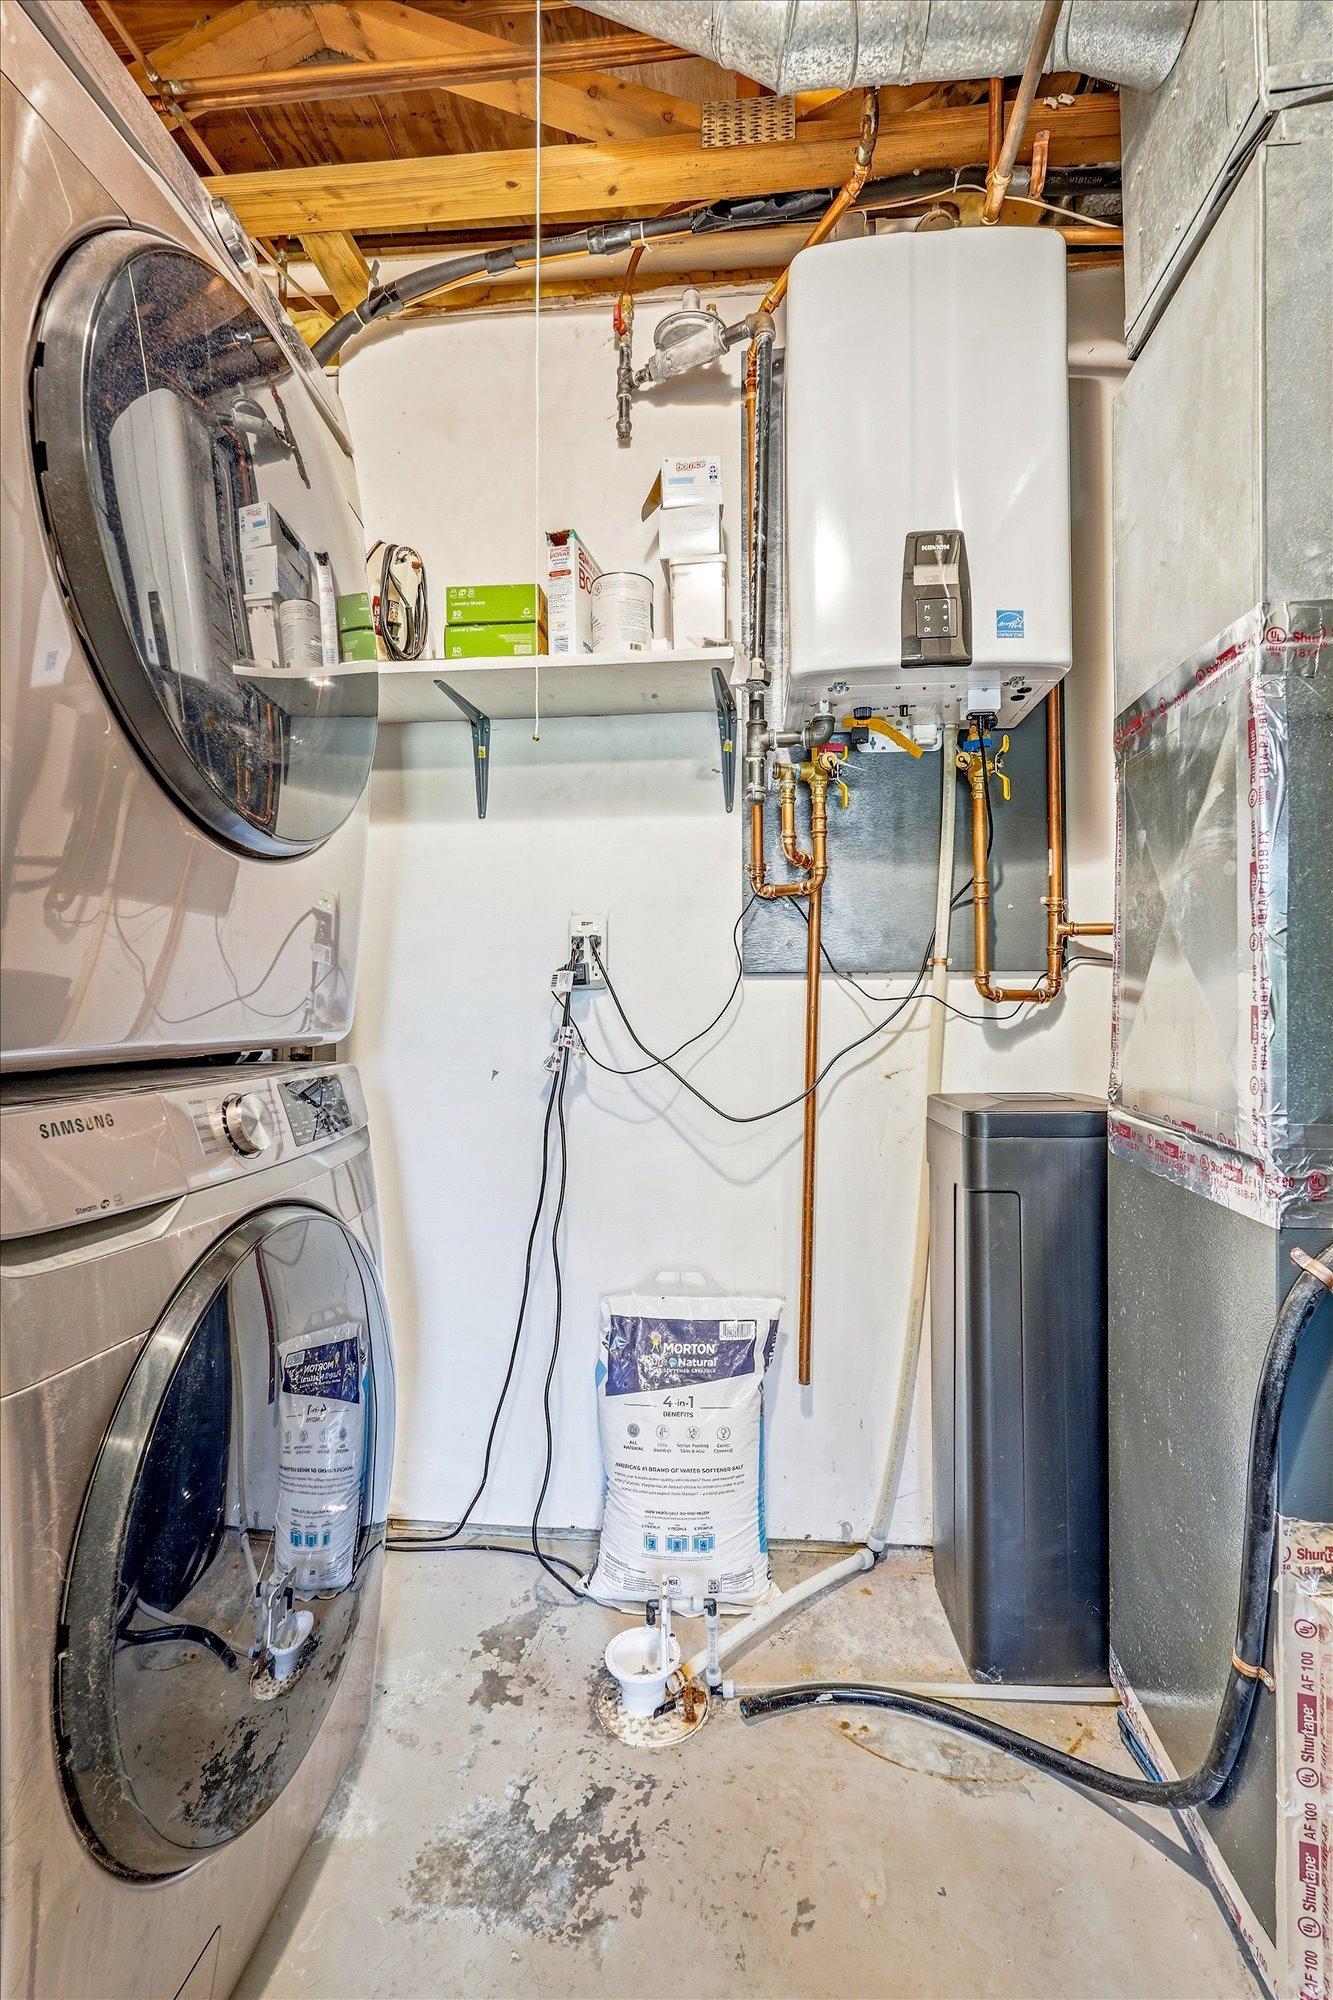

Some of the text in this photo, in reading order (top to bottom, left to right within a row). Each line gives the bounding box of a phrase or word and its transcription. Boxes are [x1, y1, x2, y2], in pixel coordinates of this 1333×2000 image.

[39, 1113, 115, 1139] SAMSUNG
[75, 1204, 97, 1216] Steam
[663, 1344, 716, 1355] MORTON
[678, 1357, 718, 1368] Natural
[663, 1396, 694, 1409] 4-in-1
[1300, 1652, 1317, 1763] Shurtape AF 100
[1304, 1825, 1316, 1840] AF
[1303, 1852, 1319, 1913] Shurtape
[1304, 1951, 1318, 1992] AF 100
